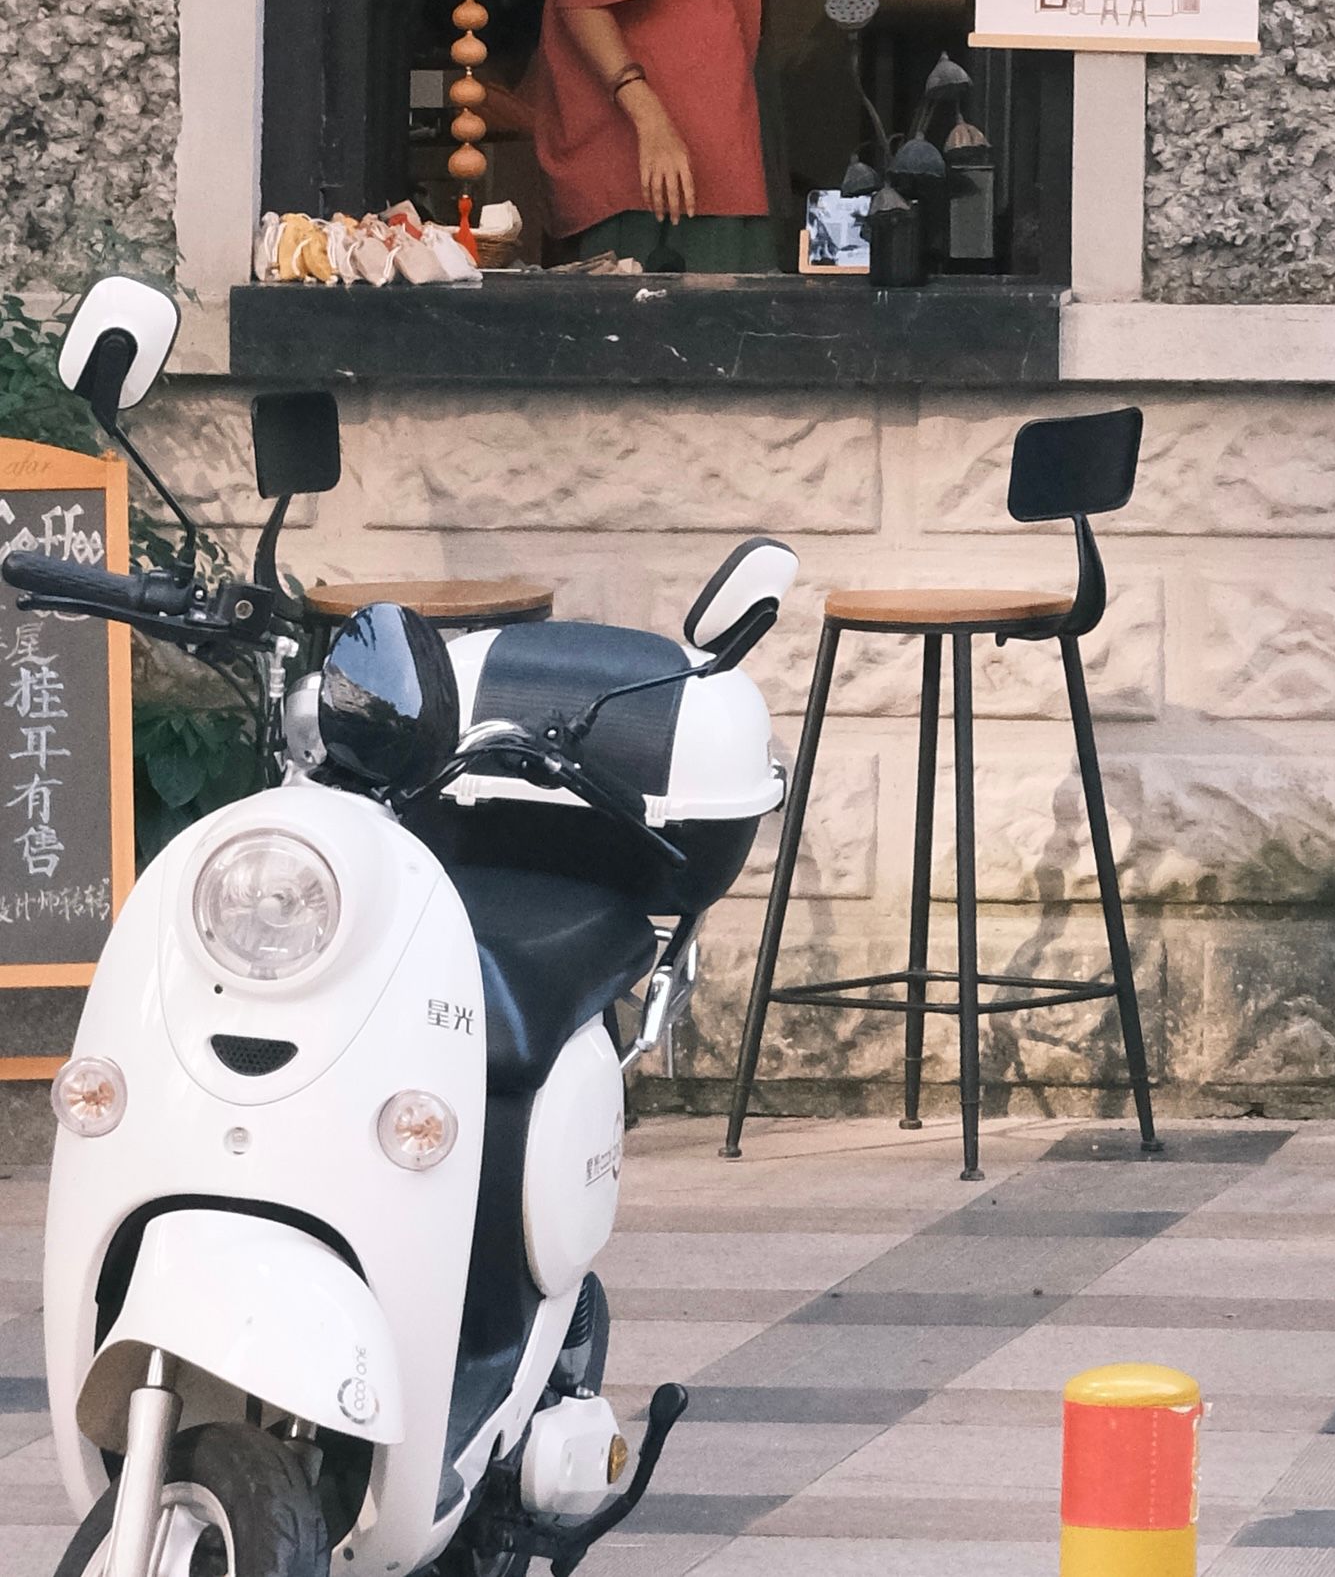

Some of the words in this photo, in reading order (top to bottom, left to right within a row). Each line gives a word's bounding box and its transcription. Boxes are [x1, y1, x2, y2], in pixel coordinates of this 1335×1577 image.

[0, 621, 59, 667] 屋
[4, 666, 71, 878] 挂耳有售
[427, 998, 475, 1036] 星光
